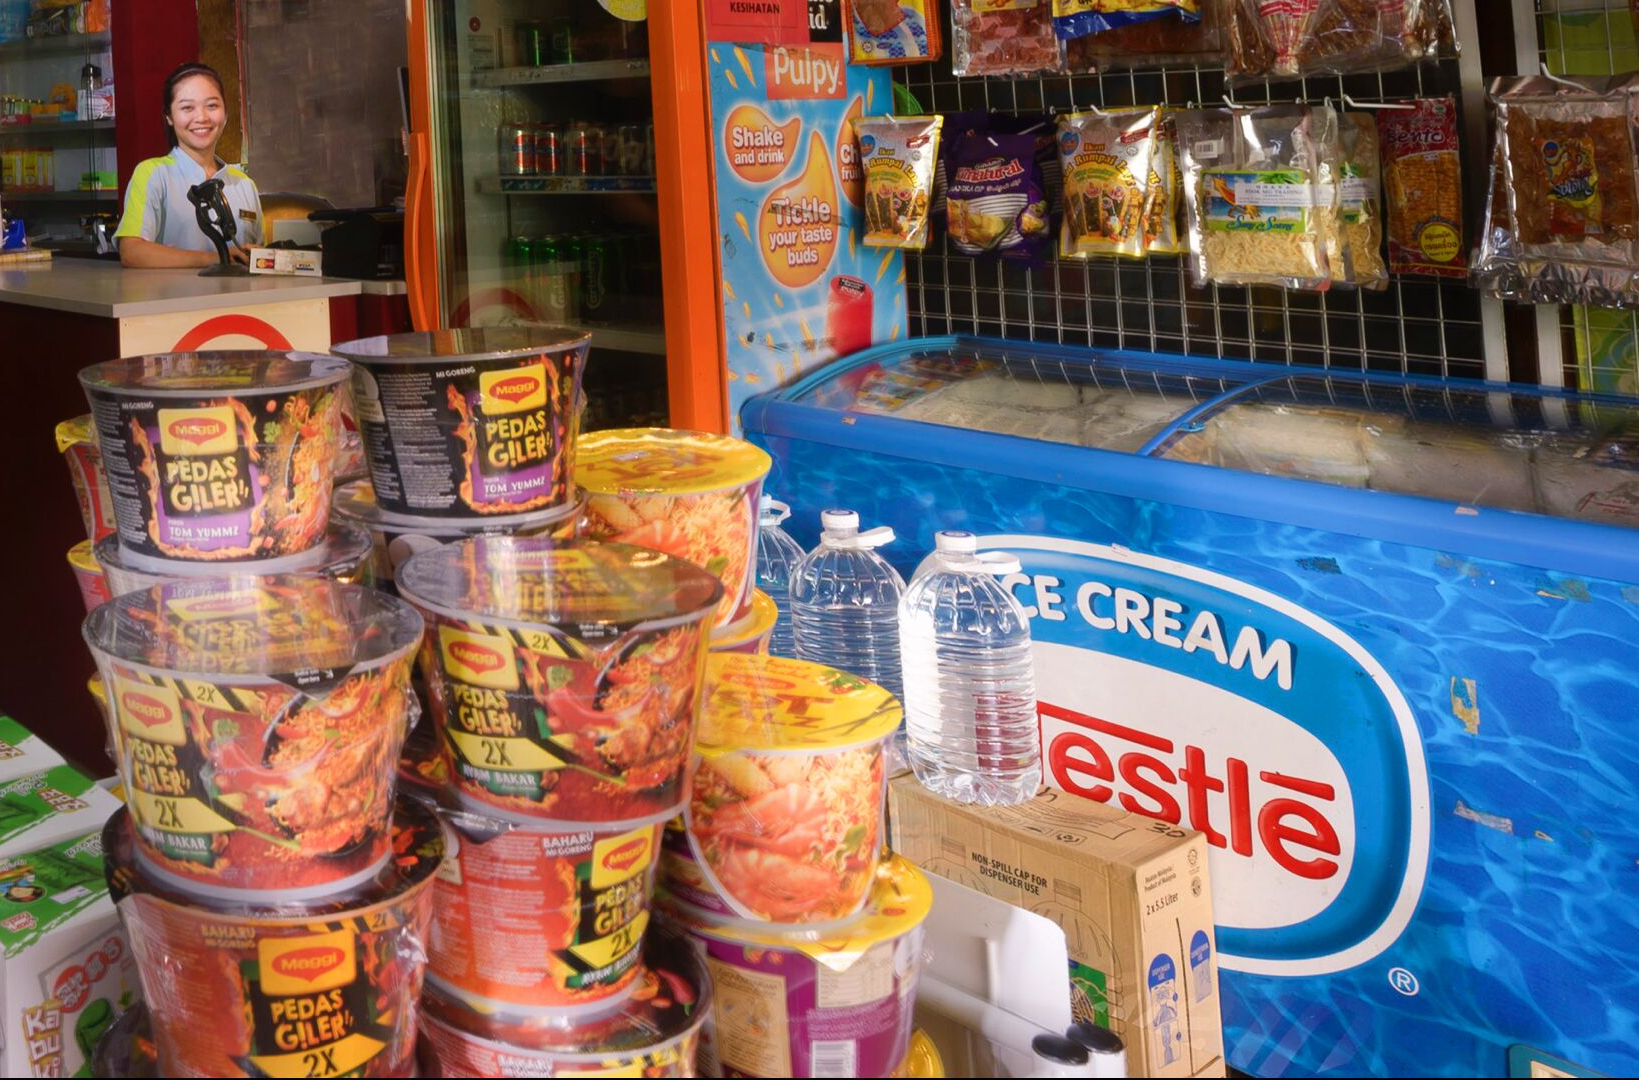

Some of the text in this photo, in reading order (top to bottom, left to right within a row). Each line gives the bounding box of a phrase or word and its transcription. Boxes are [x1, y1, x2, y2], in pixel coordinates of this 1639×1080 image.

[729, 2, 780, 15] KESIHATAN
[773, 47, 840, 94] Pulpy
[732, 126, 784, 148] Shake
[735, 149, 785, 165] and drink
[772, 196, 832, 226] Tickle
[769, 227, 833, 250] your taste
[787, 248, 818, 266] buds
[496, 382, 535, 396] Maggi
[175, 424, 220, 437] Maggi
[486, 411, 546, 442] PEDAS
[166, 457, 237, 484] PEDAS
[485, 482, 507, 494] TOM
[169, 526, 192, 538] TOM
[532, 633, 551, 651] 2X
[1010, 574, 1294, 691] CE CREAM
[196, 686, 215, 703] 2X
[453, 684, 509, 709] PEDAS
[129, 739, 177, 766] PEDAS
[481, 740, 512, 766] 2X
[495, 769, 537, 785] BAKAR
[154, 797, 183, 828] 2X
[168, 835, 208, 850] BAKAR
[542, 831, 594, 849] BAHARU
[971, 852, 1048, 888] NON-SPILL CAP FOR
[979, 865, 1041, 896] DISPENSER USE
[1155, 898, 1165, 909] 5.5
[1165, 893, 1179, 906] Liter
[611, 925, 633, 958] 2X
[280, 953, 337, 971] Maggi
[270, 989, 343, 1024] PEDAS
[303, 1048, 338, 1078] 2X
